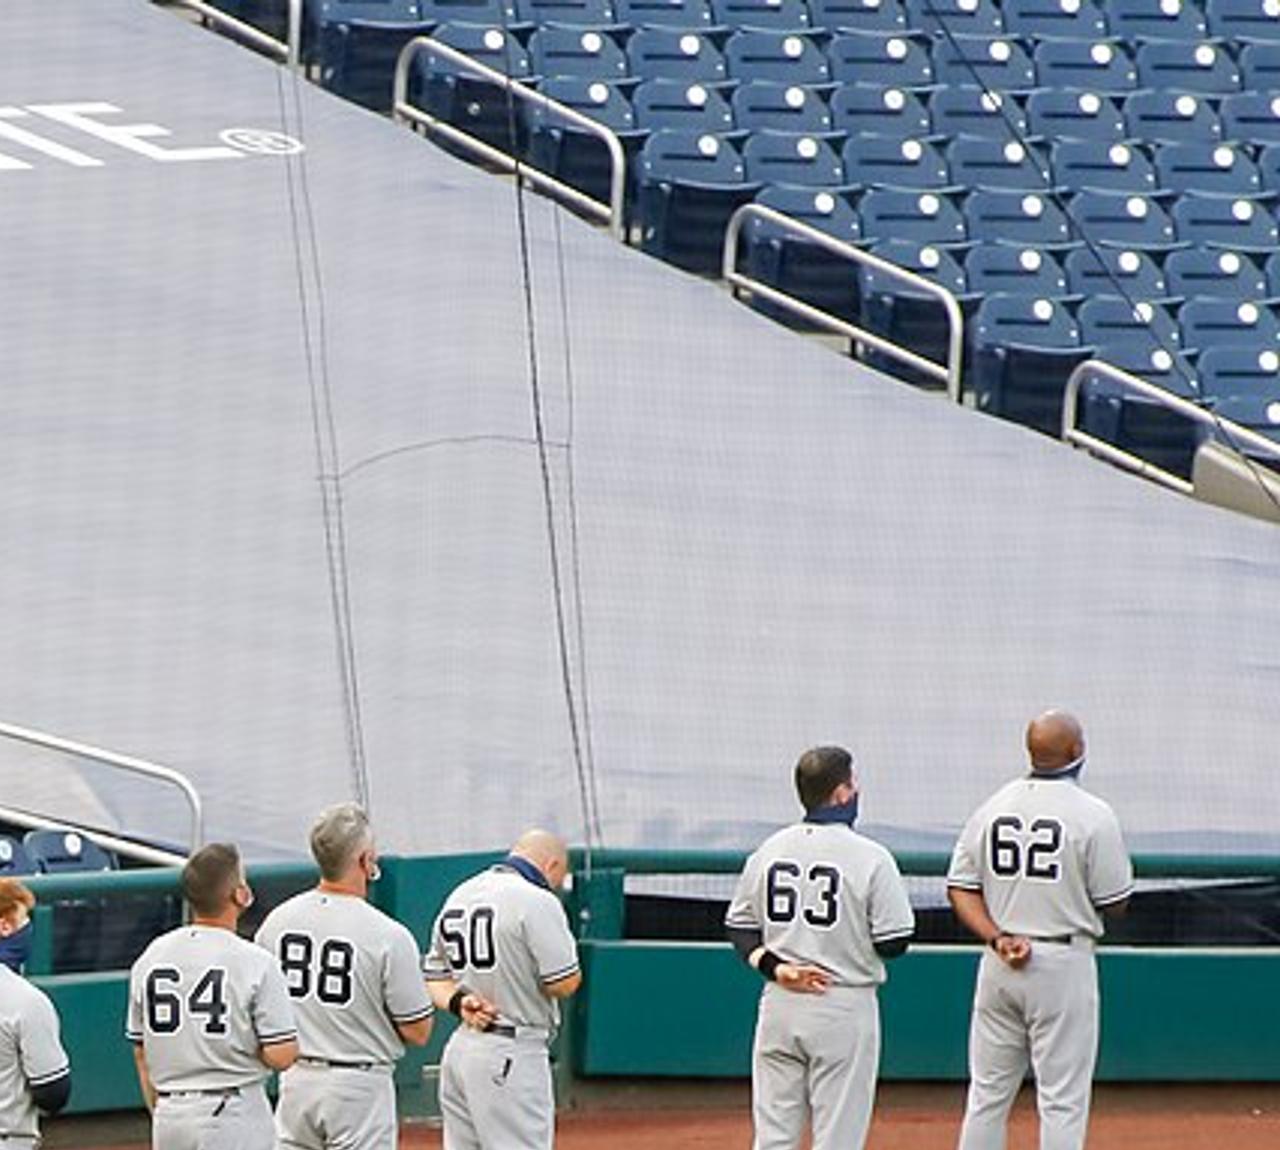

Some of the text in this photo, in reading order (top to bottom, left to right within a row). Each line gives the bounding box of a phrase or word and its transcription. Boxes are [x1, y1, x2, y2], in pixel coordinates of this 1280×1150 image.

[989, 815, 1063, 881] 62
[765, 861, 841, 928] 63
[278, 931, 354, 1005] 88
[439, 905, 497, 971] 50
[144, 967, 228, 1036] 64
